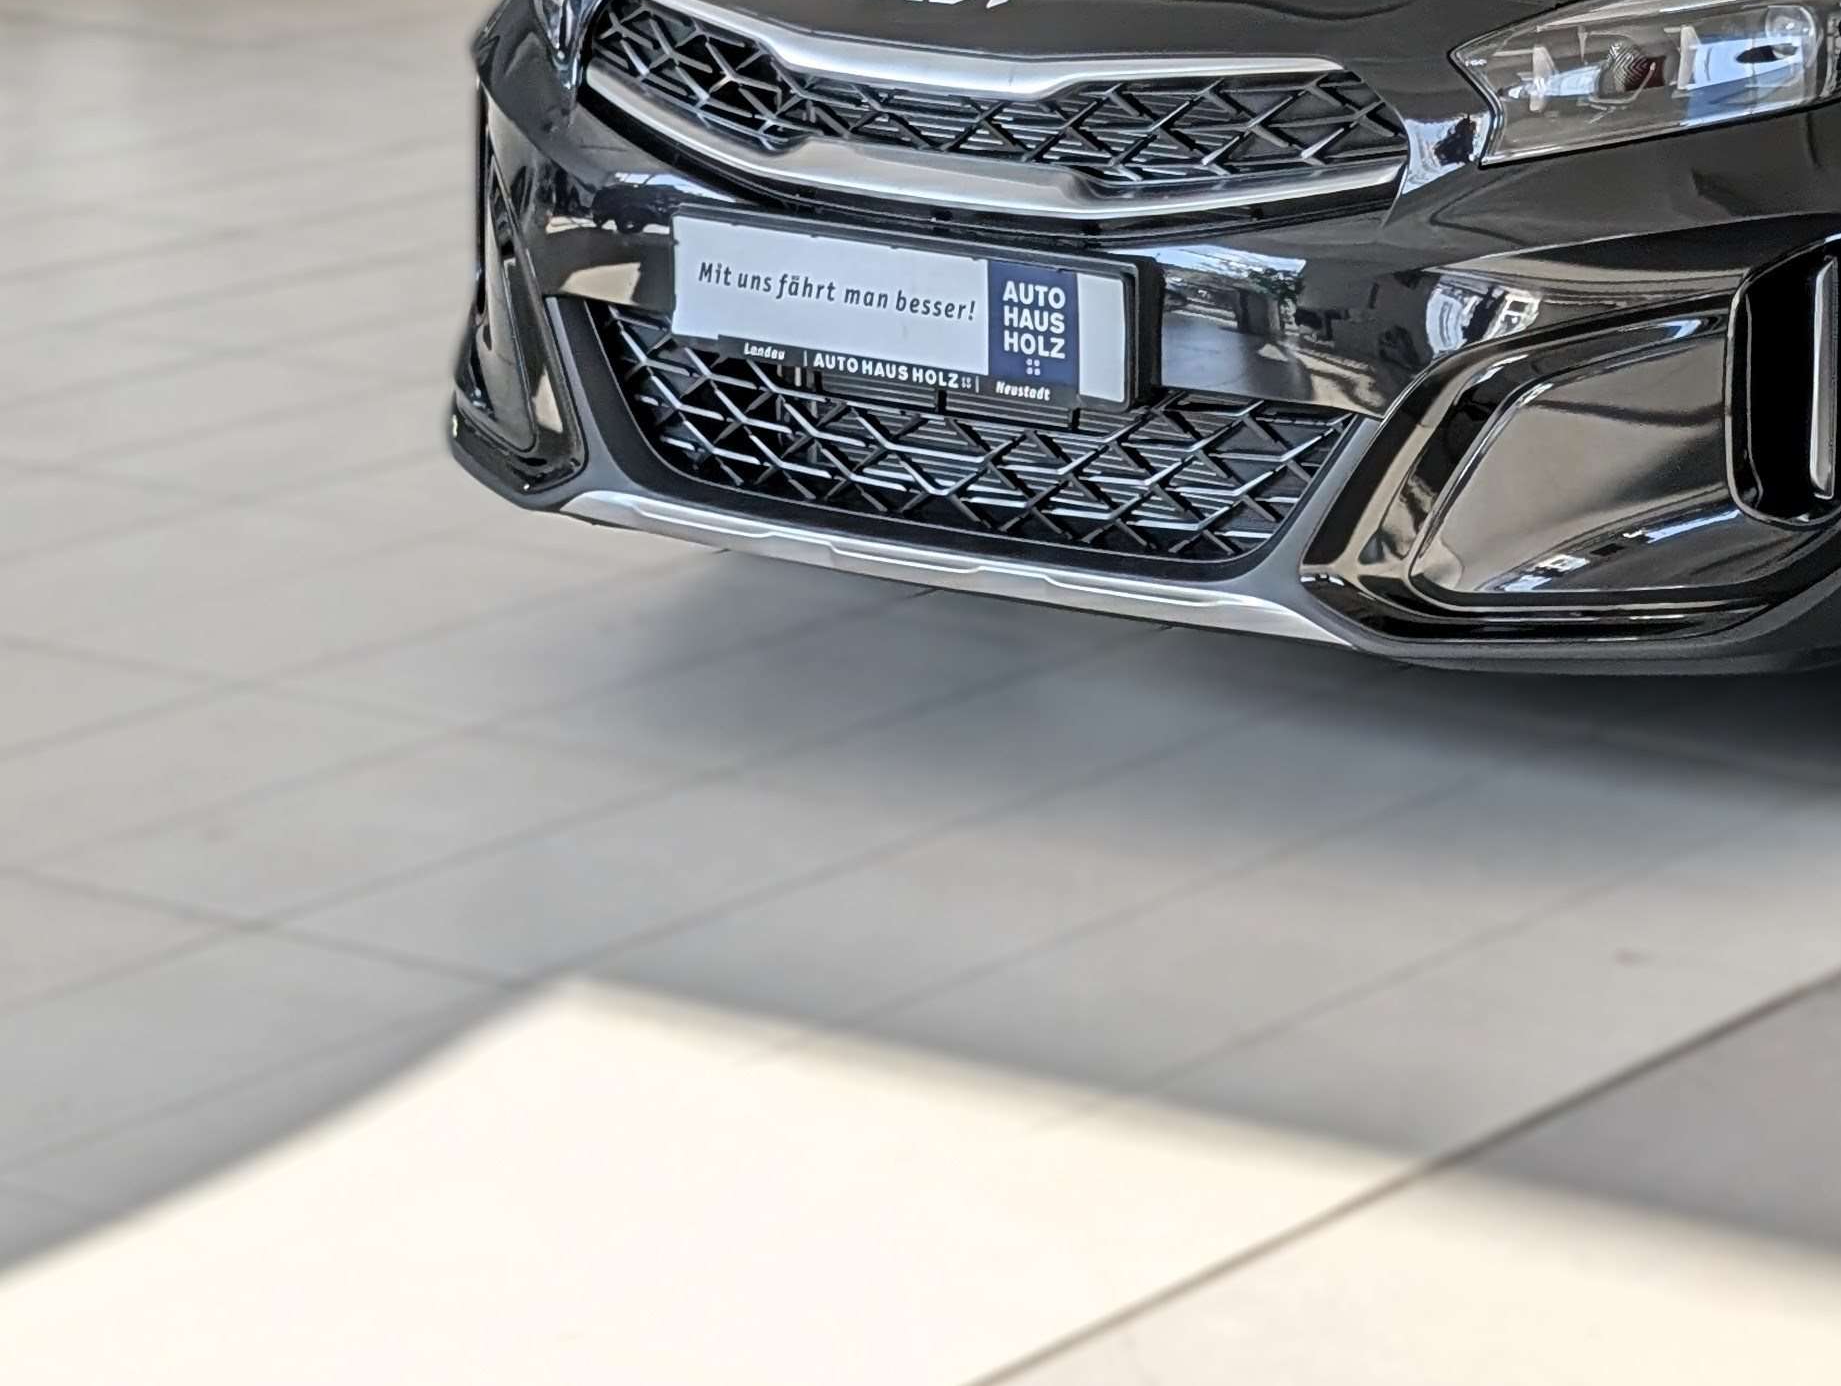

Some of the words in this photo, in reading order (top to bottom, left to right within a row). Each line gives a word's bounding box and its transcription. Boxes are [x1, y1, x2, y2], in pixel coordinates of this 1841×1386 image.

[699, 262, 731, 286] Mit
[738, 272, 772, 292] uns
[776, 273, 836, 301] fährt
[844, 288, 888, 309] man
[895, 289, 976, 321] besser!
[1002, 280, 1066, 309] AUTO
[1003, 305, 1065, 334] HAUS
[1003, 330, 1066, 359] HOLZ
[912, 367, 960, 389] HOLZ
[995, 381, 1051, 401] Neustadt
